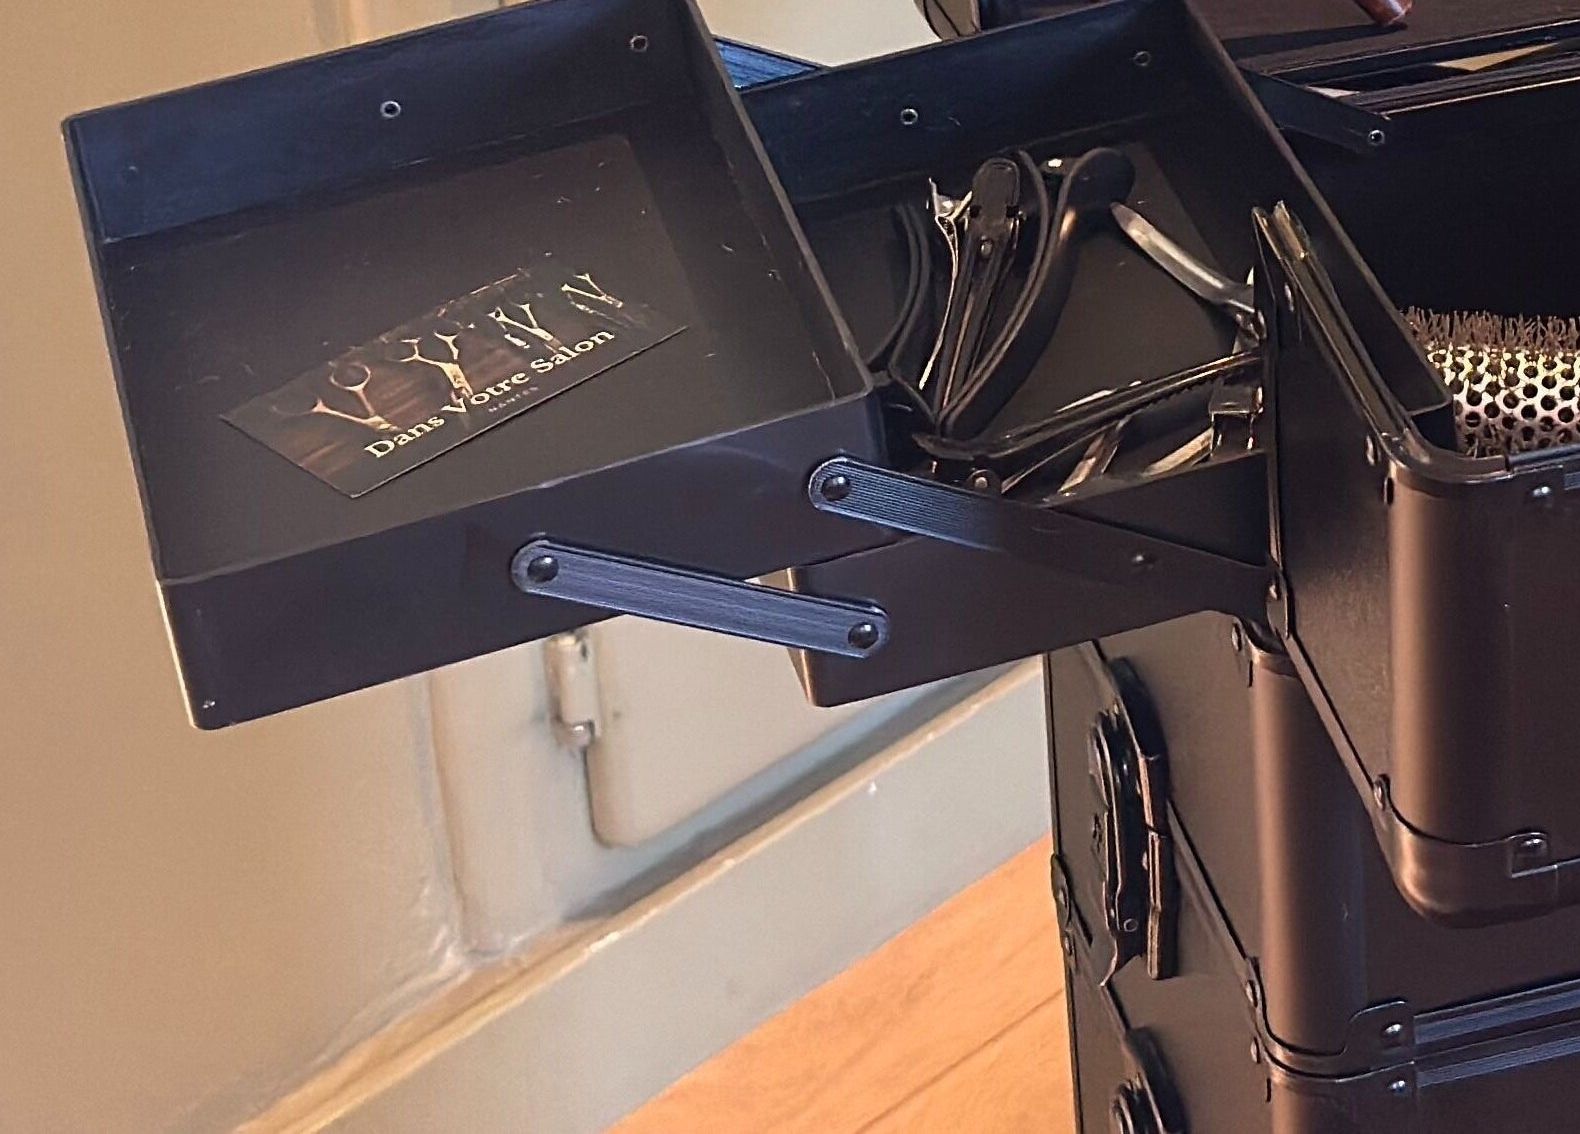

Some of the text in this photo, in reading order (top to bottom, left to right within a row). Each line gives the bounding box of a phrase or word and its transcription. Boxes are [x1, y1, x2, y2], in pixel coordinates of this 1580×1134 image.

[364, 329, 615, 458] Dans Votre Salon
